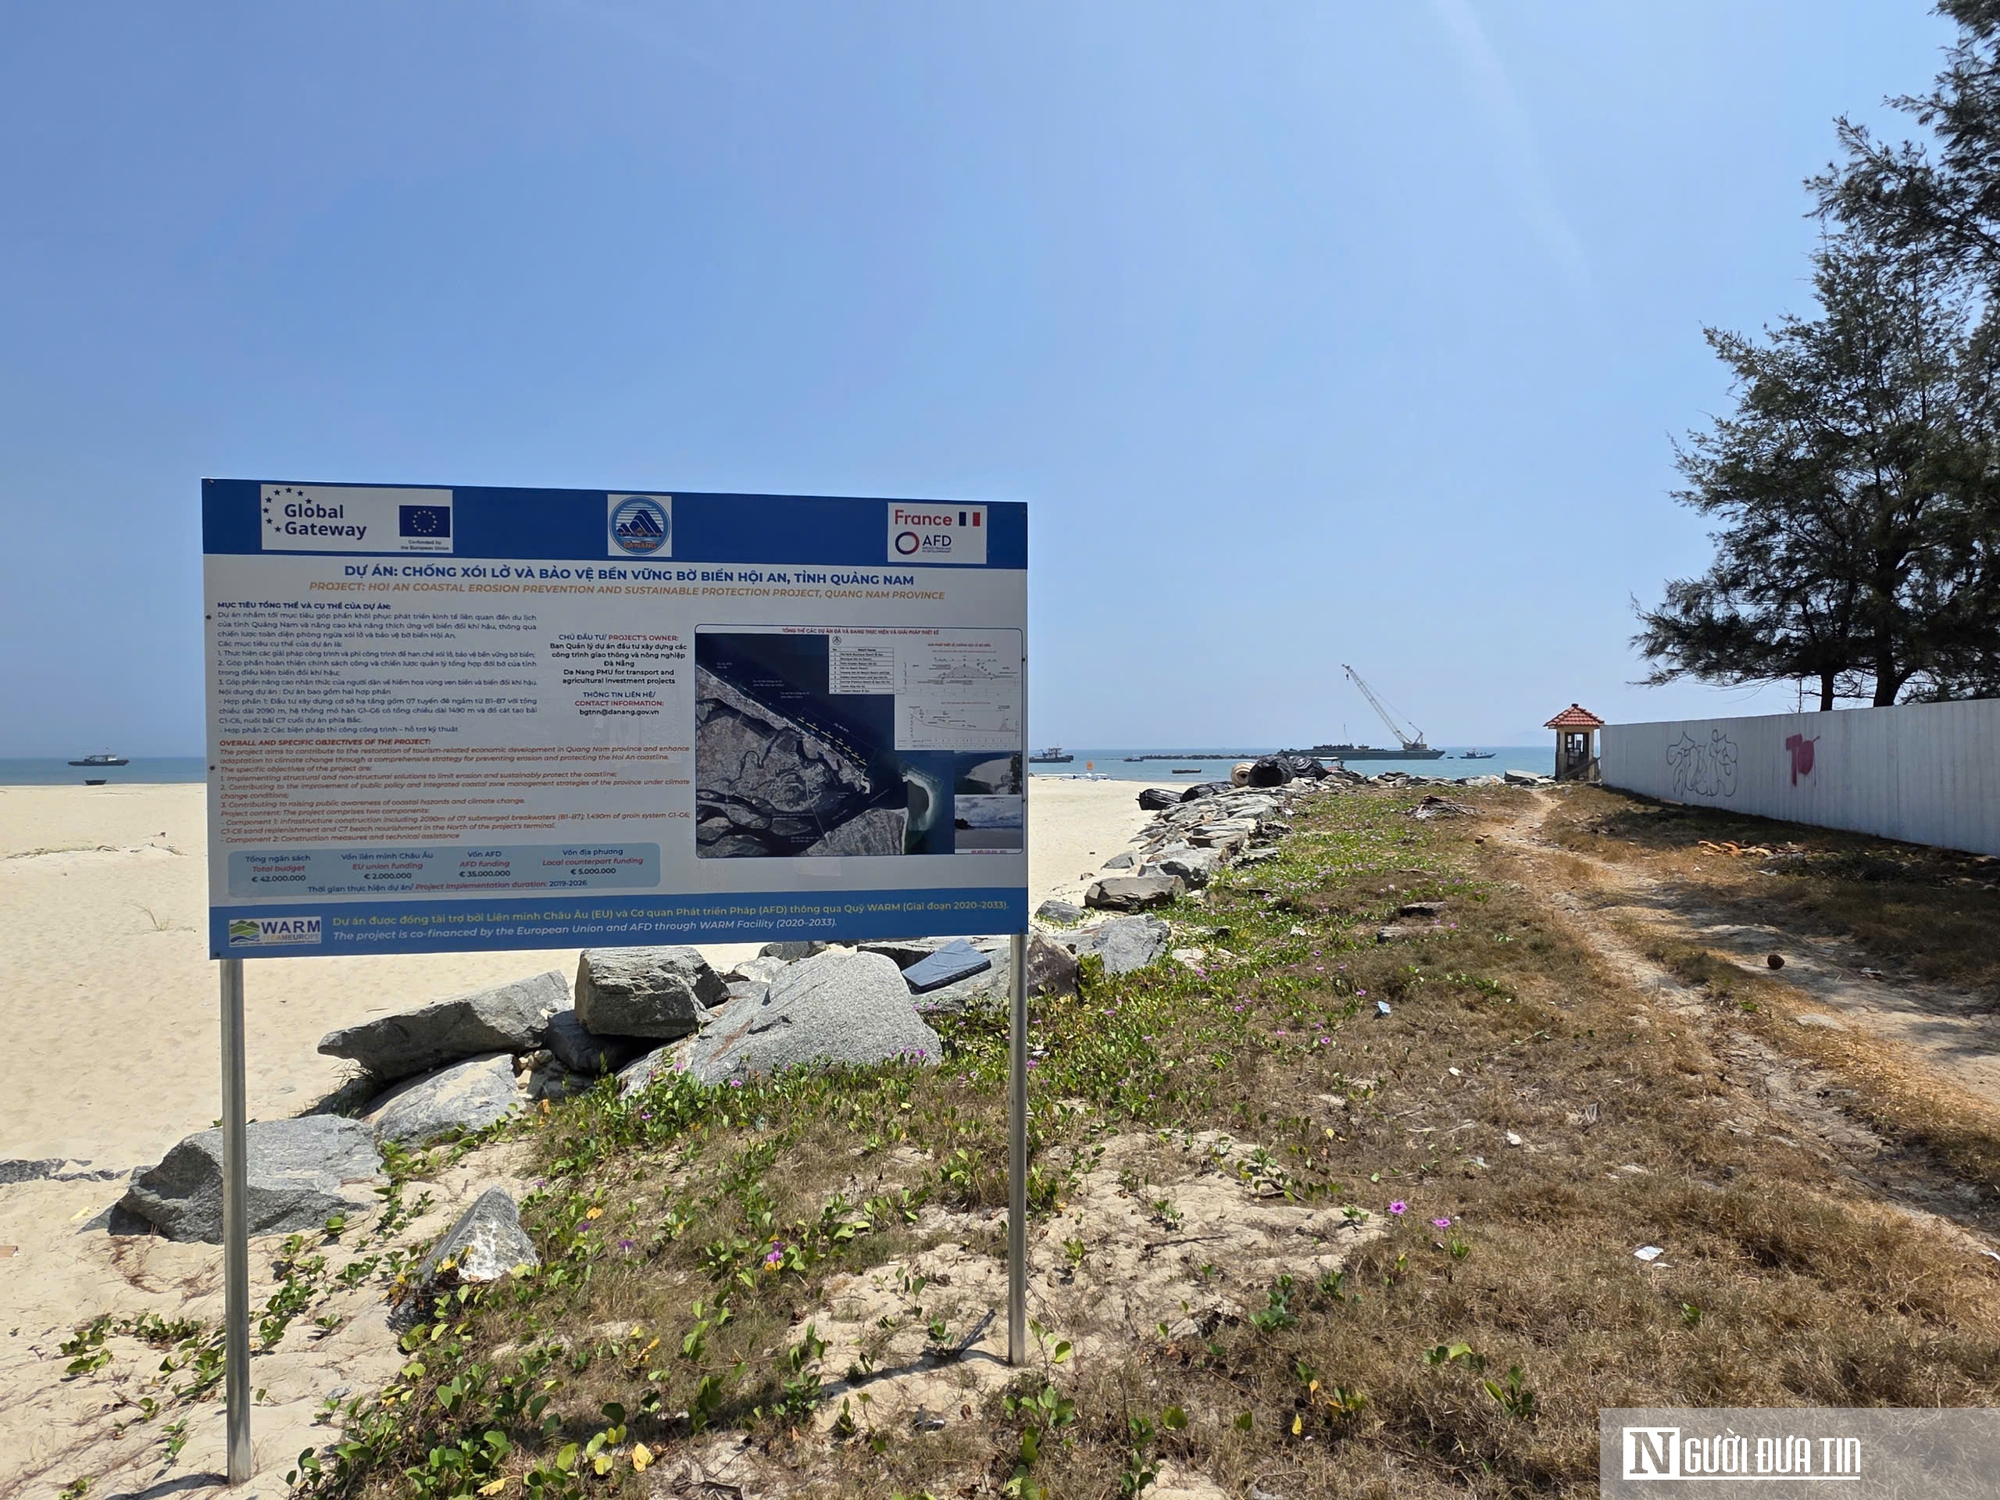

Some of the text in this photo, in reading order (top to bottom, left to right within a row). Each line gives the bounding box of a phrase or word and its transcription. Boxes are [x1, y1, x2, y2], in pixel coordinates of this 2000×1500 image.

[285, 503, 343, 518] Global
[895, 510, 952, 526] France
[285, 522, 366, 540] Gateway
[922, 535, 951, 547] AFD
[344, 564, 914, 586] DỰ ÁN: CHỐNG XÓI LỞ VÀ BẢO VỆ BỀN VỮNG BỜ BIỂN HỘI AN, TỈNH QUẢNG NAM
[309, 582, 365, 591] PROJECT:
[368, 582, 390, 591] HOI
[392, 583, 410, 592] AN
[412, 583, 465, 592] COASTAL
[468, 584, 520, 593] EROSION
[522, 585, 594, 594] PREVENTION
[596, 586, 622, 594] AND
[624, 586, 699, 595] SUSTAINABLE
[701, 587, 770, 597] PROTECTION
[772, 588, 821, 598] PROJECT,
[824, 590, 862, 599] QUANG
[892, 591, 944, 600] PROVINCE
[575, 669, 594, 678] Nang
[245, 856, 266, 864] Tổng
[268, 855, 289, 864] ngân
[391, 862, 423, 870] funding
[613, 857, 643, 866] funding
[327, 886, 345, 894] gian
[332, 918, 349, 926] Dự
[352, 917, 366, 925] án
[368, 916, 396, 925] được
[399, 915, 428, 926] đồng
[431, 914, 445, 923] tài
[448, 915, 464, 923] trợ
[466, 912, 483, 922] bởi
[486, 913, 509, 921] Liên
[512, 912, 541, 921] minh
[543, 911, 570, 920] Châu
[574, 910, 588, 919] Âu
[591, 910, 612, 920] (EU)
[615, 910, 627, 918] và
[630, 909, 644, 917] Cơ
[646, 910, 673, 918] quan
[676, 907, 700, 916] Phát
[702, 906, 726, 916] triển
[730, 906, 756, 916] Pháp
[759, 906, 787, 916] (AFD)
[790, 904, 820, 915] thông
[822, 906, 841, 914] qua
[844, 904, 864, 914] Quỹ
[866, 903, 900, 911] WARM
[903, 902, 924, 912] (Giai
[926, 902, 951, 911] đoạn
[260, 920, 320, 934] WARM
[333, 932, 354, 940] The
[356, 931, 396, 941] project
[398, 930, 407, 939] is
[410, 928, 477, 938] co-financed
[480, 928, 494, 938] by
[496, 927, 514, 936] the
[516, 926, 569, 936] European
[572, 924, 603, 933] Union
[606, 923, 627, 932] and
[628, 923, 652, 931] AFD
[654, 922, 696, 932] through
[700, 921, 734, 929] WARM
[736, 919, 774, 930] Facility
